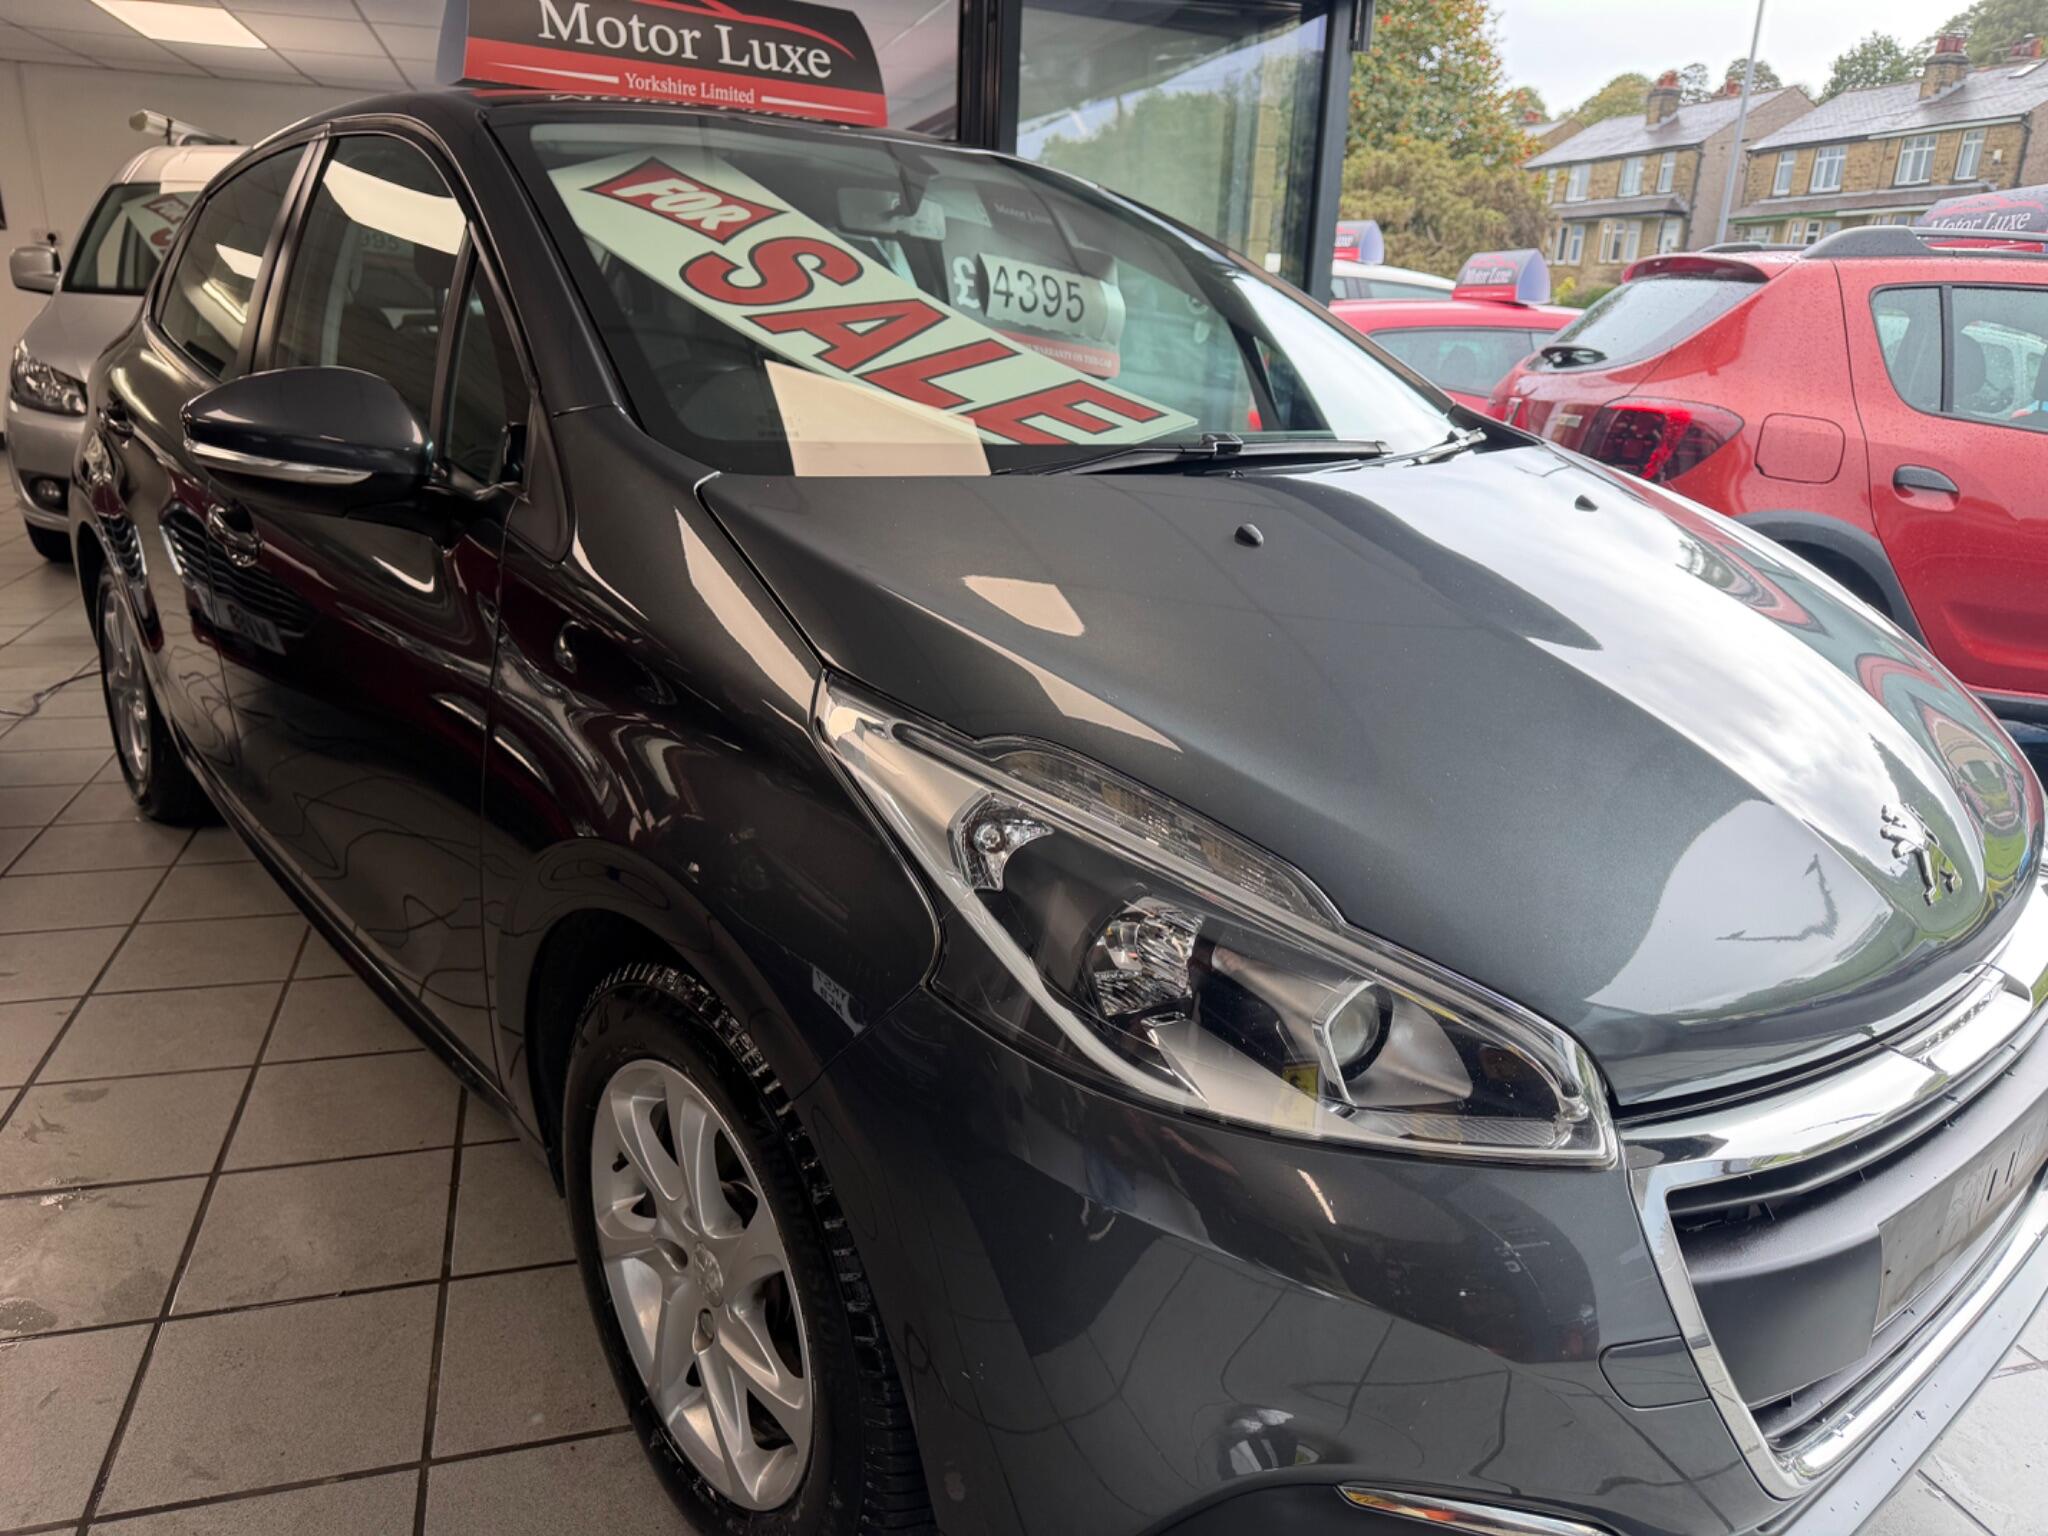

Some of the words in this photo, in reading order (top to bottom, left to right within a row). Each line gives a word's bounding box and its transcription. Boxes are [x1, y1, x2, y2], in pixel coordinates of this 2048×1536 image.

[538, 0, 701, 60] Motor
[714, 23, 832, 78] Luxe
[624, 72, 697, 98] Yorkshire
[700, 82, 756, 105] Limited
[613, 177, 753, 232] FOR
[1983, 211, 2031, 232] Luxe
[993, 265, 1085, 323] 4395
[679, 236, 1167, 445] SALE
